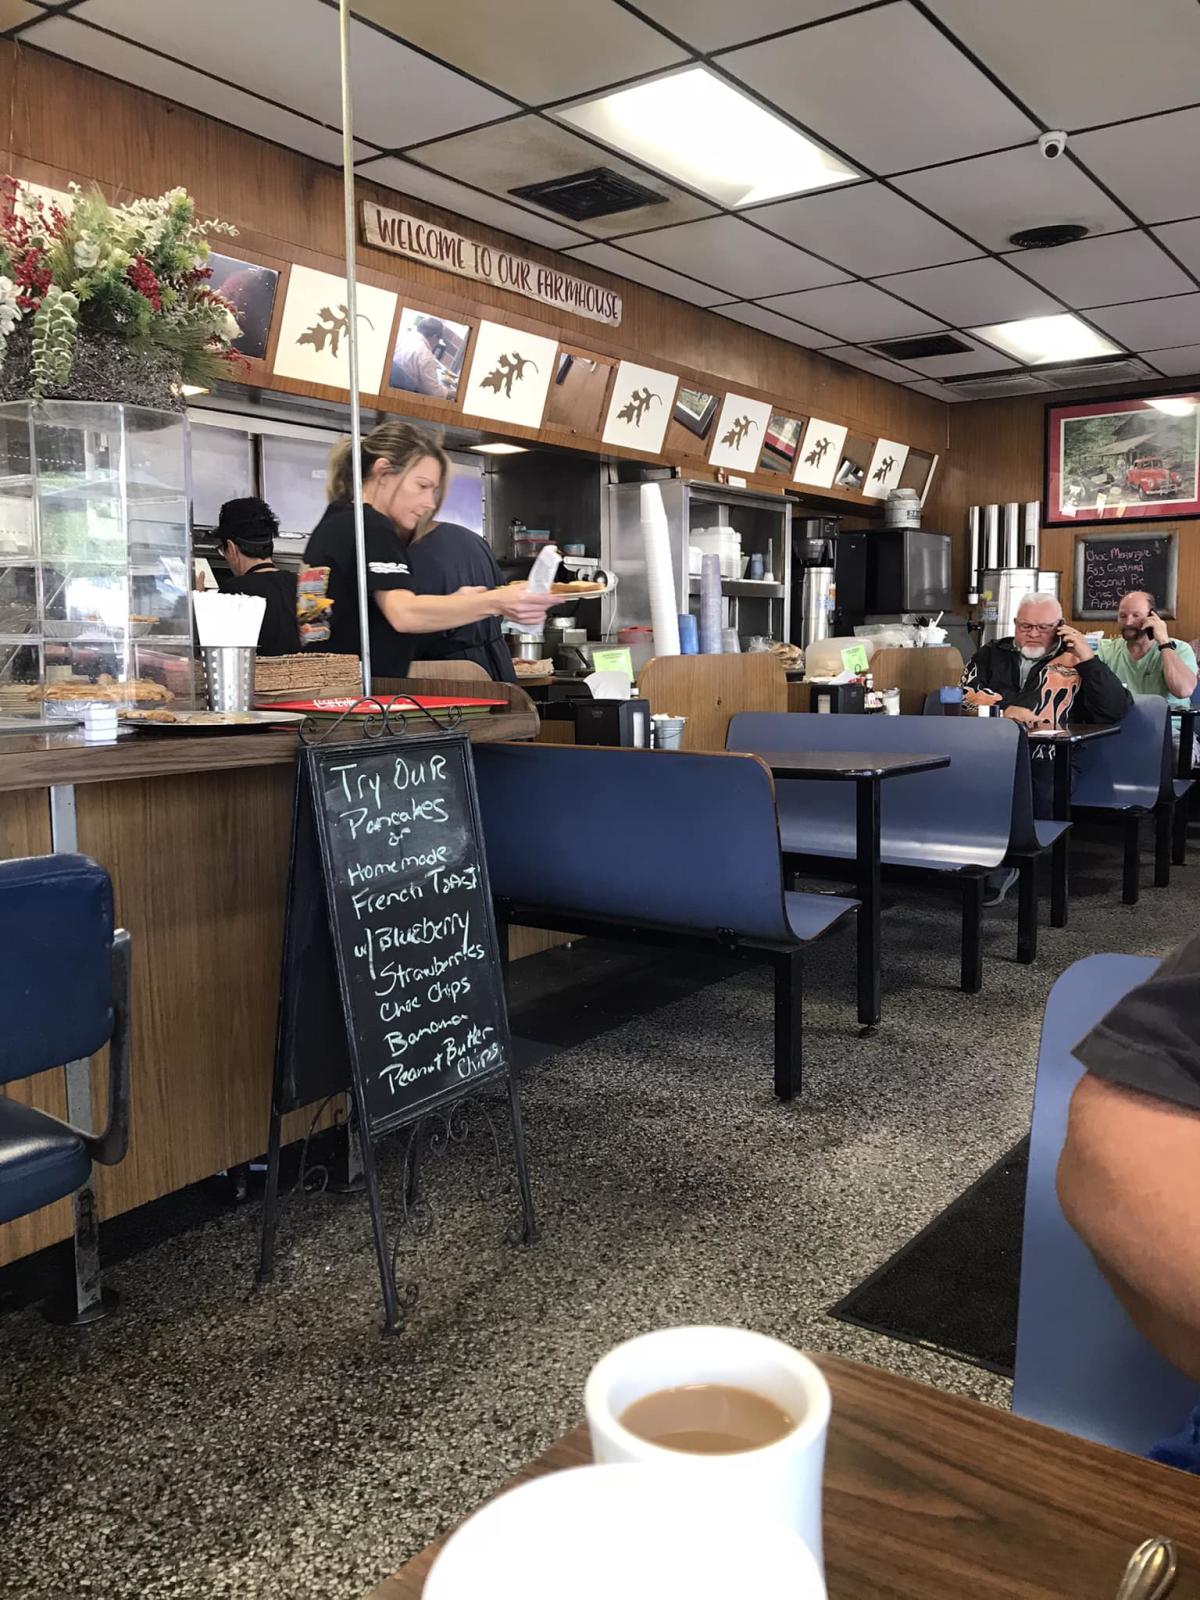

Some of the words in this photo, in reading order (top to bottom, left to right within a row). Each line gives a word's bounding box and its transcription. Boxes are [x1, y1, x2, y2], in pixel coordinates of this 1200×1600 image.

[376, 208, 466, 270] WELCOME
[471, 242, 492, 278] TO
[498, 254, 532, 293] OUR
[537, 268, 619, 320] FARMHOUSE
[1086, 575, 1126, 588] Coconut
[330, 763, 381, 809] Try
[339, 797, 449, 840] Pancakes
[388, 827, 411, 846] or
[351, 881, 424, 920] French
[375, 943, 486, 997] Strawberries
[379, 995, 422, 1022] Choc
[427, 976, 472, 1003] Chips
[384, 1012, 469, 1058] Banana
[378, 1052, 443, 1095] Peanut
[441, 1023, 494, 1066] Butter
[457, 1041, 499, 1079] Chips
